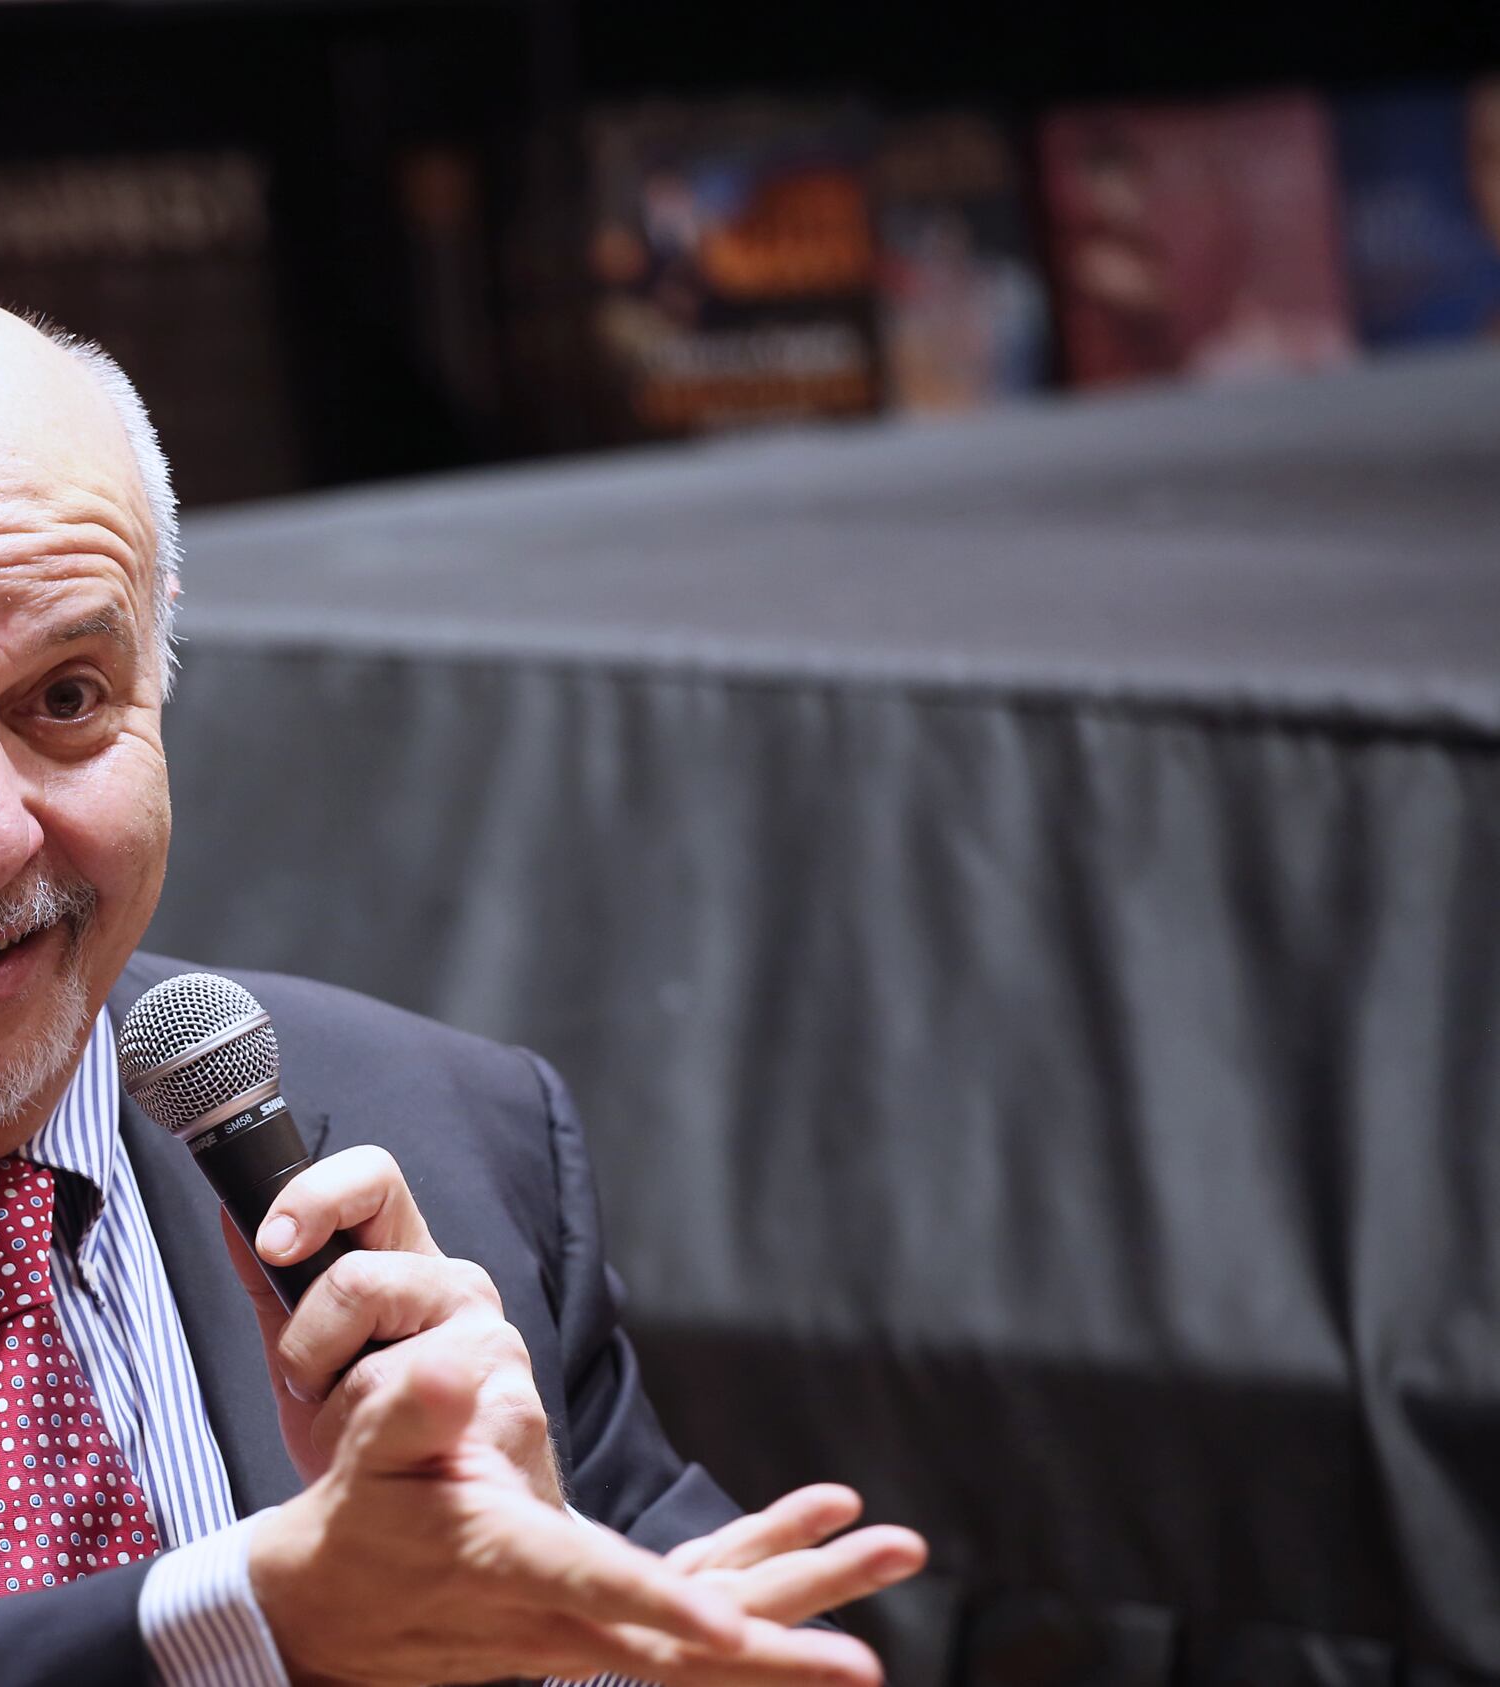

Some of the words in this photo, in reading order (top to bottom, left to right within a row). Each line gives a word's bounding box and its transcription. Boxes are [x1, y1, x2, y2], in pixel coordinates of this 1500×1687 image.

[192, 1131, 218, 1152] URE
[224, 1113, 253, 1134] SM58
[259, 1096, 287, 1117] SHUR
